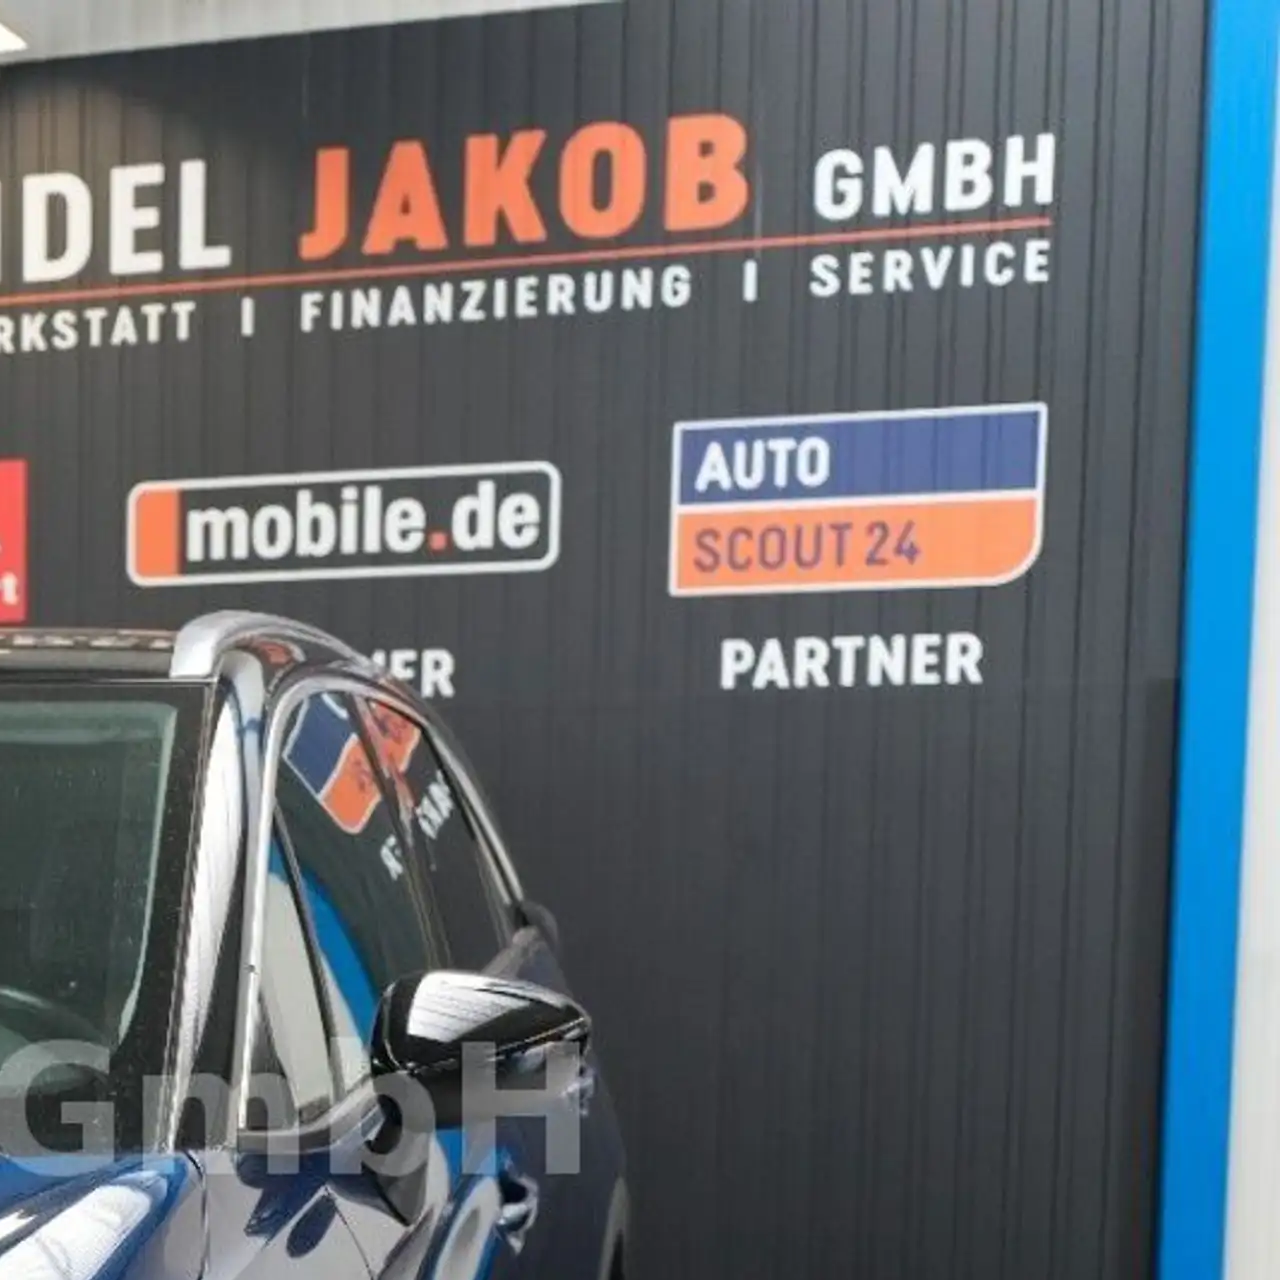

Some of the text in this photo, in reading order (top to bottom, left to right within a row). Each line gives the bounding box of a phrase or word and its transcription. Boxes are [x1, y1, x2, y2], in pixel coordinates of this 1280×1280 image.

[298, 113, 749, 261] JAKOB
[814, 132, 1056, 221] GMBH
[299, 265, 692, 333] FINANZIERUNG
[809, 239, 1051, 297] SERVICE
[693, 436, 831, 493] AUTO
[186, 479, 541, 562] mobile.de
[719, 631, 984, 690] PARTNER
